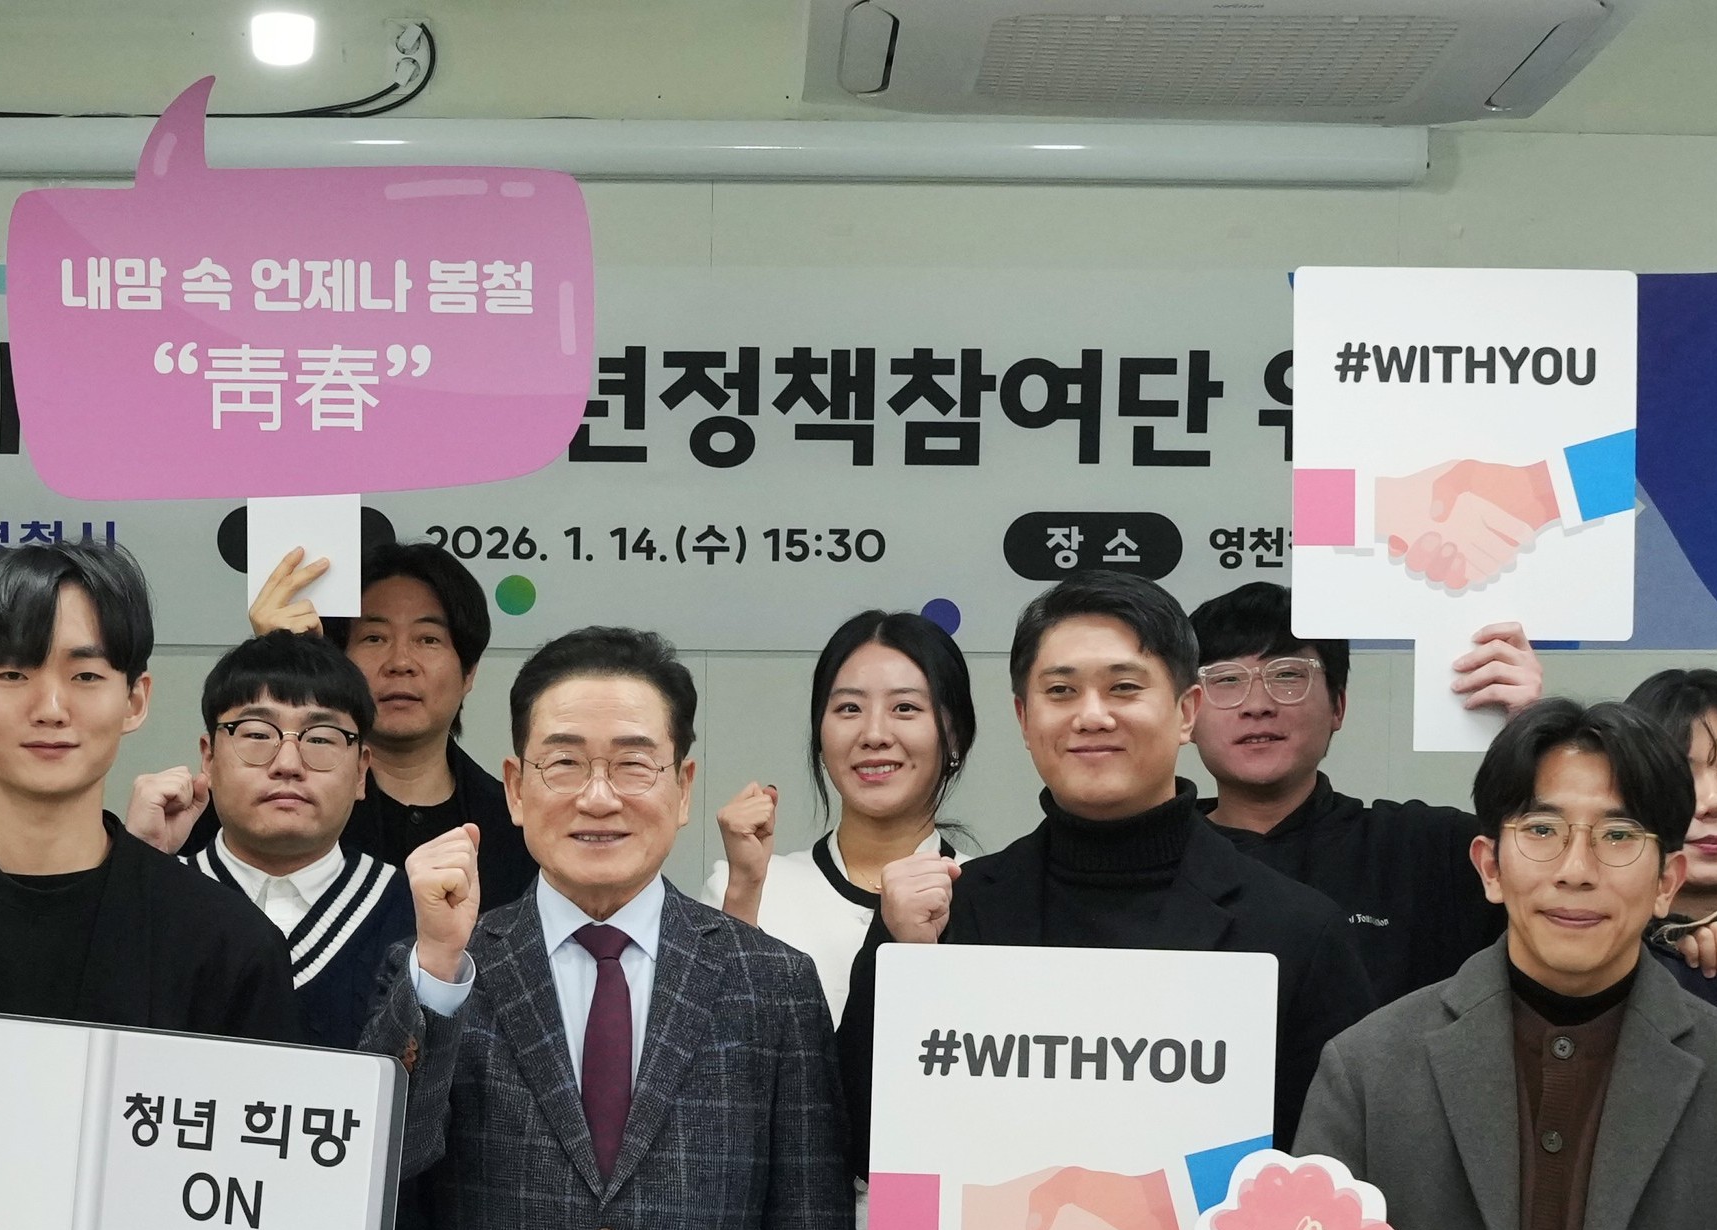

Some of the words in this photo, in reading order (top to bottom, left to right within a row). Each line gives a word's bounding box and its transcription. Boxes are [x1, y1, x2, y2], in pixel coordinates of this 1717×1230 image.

[62, 257, 167, 310] 내맘
[182, 257, 232, 310] 속
[251, 259, 412, 312] 언제나
[428, 260, 533, 314] 봄철
[1335, 342, 1595, 385] #WITHYOU
[569, 346, 1223, 468] 년정책참여단
[564, 527, 593, 561] 1.
[763, 529, 885, 562] 15:30
[1210, 527, 1283, 569] 영천
[919, 1029, 1226, 1084] #WITHYOU
[123, 1093, 216, 1151] 청년
[241, 1101, 360, 1167] 희망
[183, 1173, 263, 1229] ON
